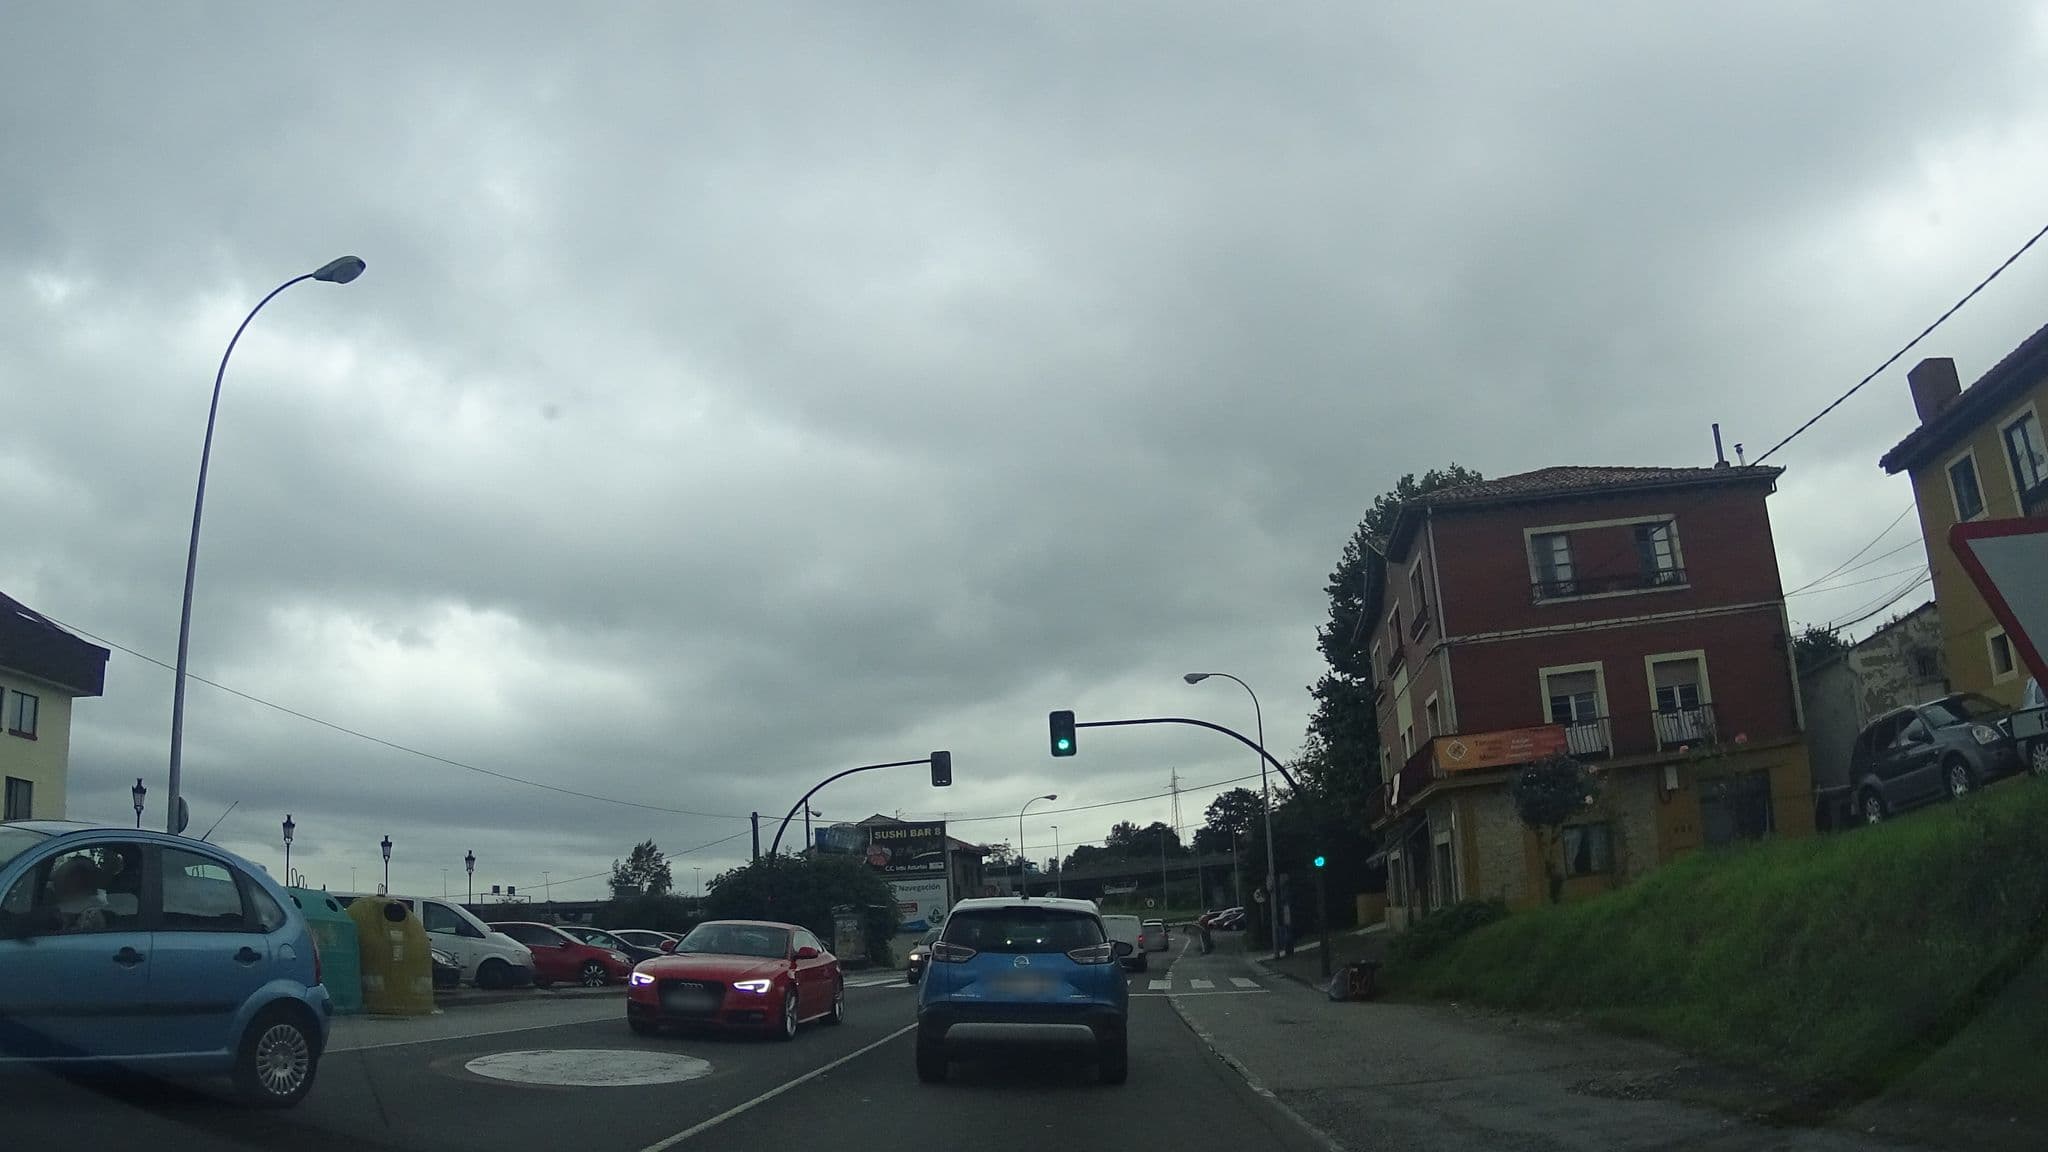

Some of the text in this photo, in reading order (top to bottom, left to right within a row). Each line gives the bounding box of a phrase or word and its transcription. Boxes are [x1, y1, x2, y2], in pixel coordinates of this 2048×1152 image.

[874, 830, 907, 840] SUSHI
[910, 828, 932, 837] BAR
[897, 883, 941, 893] Navegación
